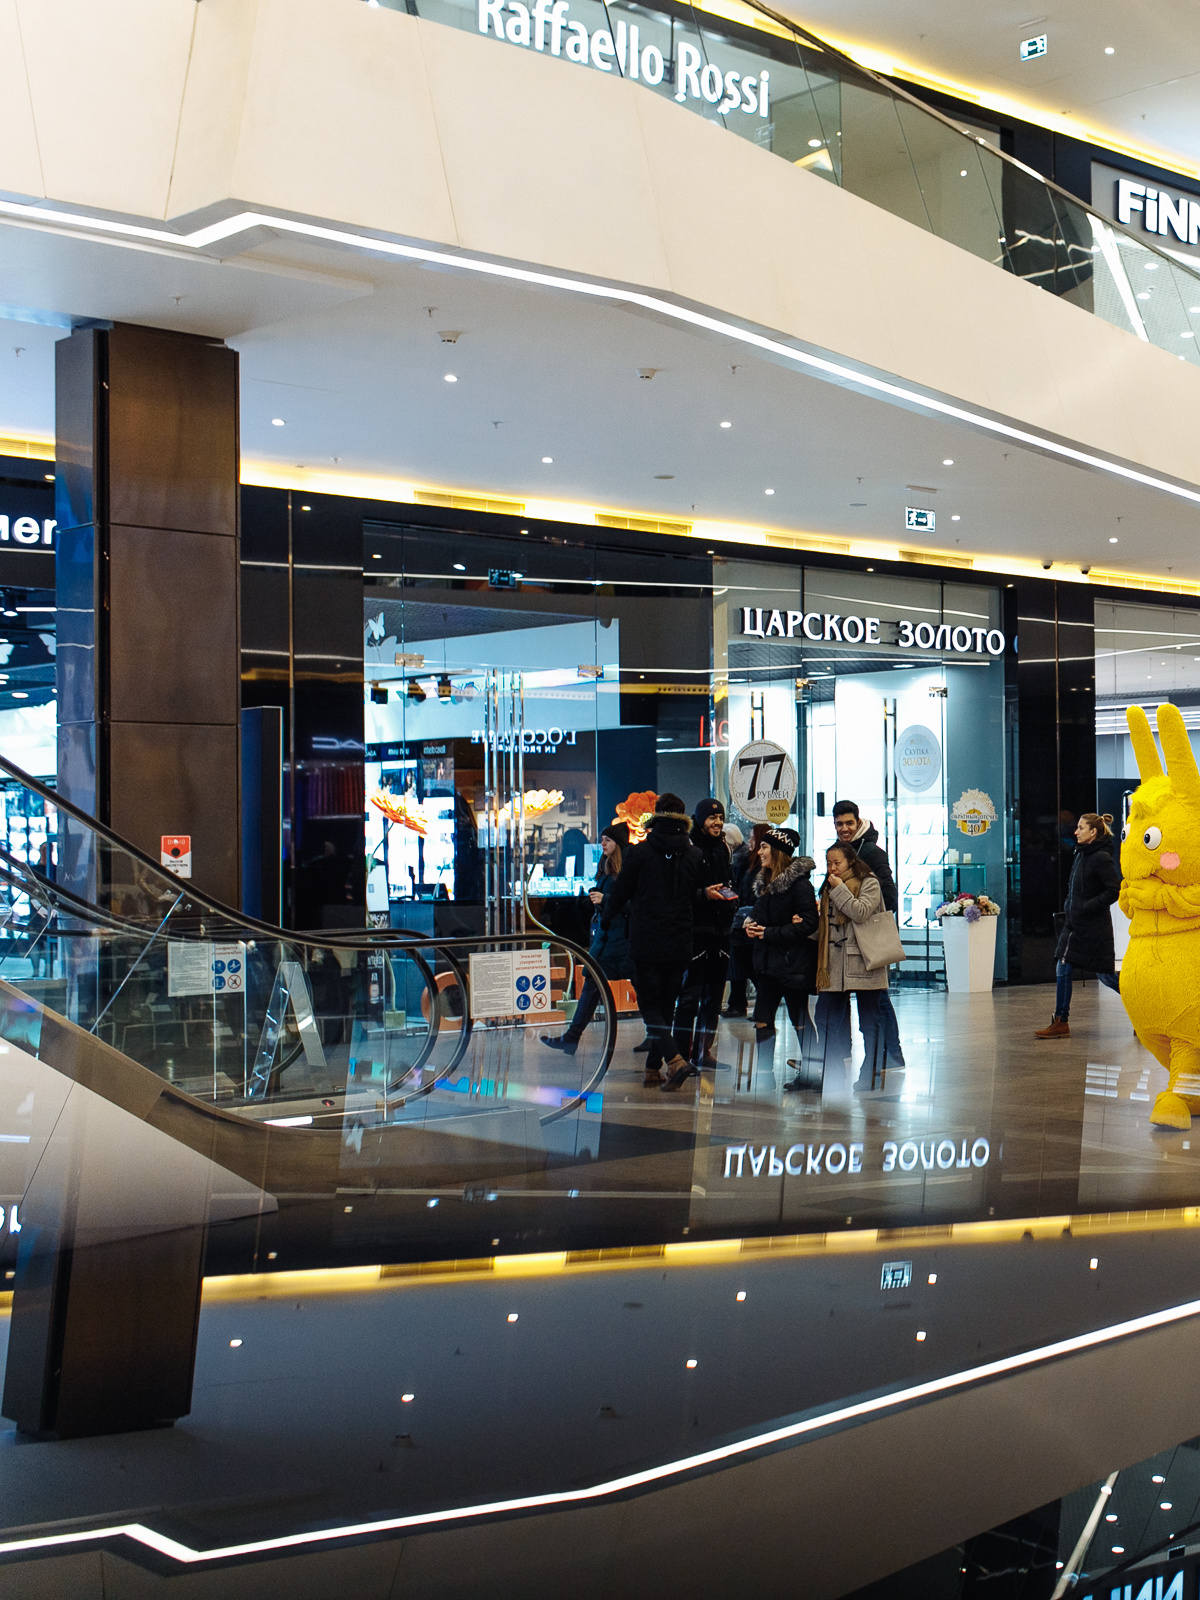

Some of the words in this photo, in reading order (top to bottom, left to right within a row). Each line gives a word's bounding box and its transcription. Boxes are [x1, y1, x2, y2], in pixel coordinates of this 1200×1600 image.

[478, 0, 665, 86] Raffaello
[675, 41, 770, 118] Rossi
[742, 606, 881, 645] ЦАРСКОЕ
[898, 620, 1006, 656] ЗОЛОТО
[738, 753, 787, 801] 77
[902, 757, 932, 767] ЗОЛОТА
